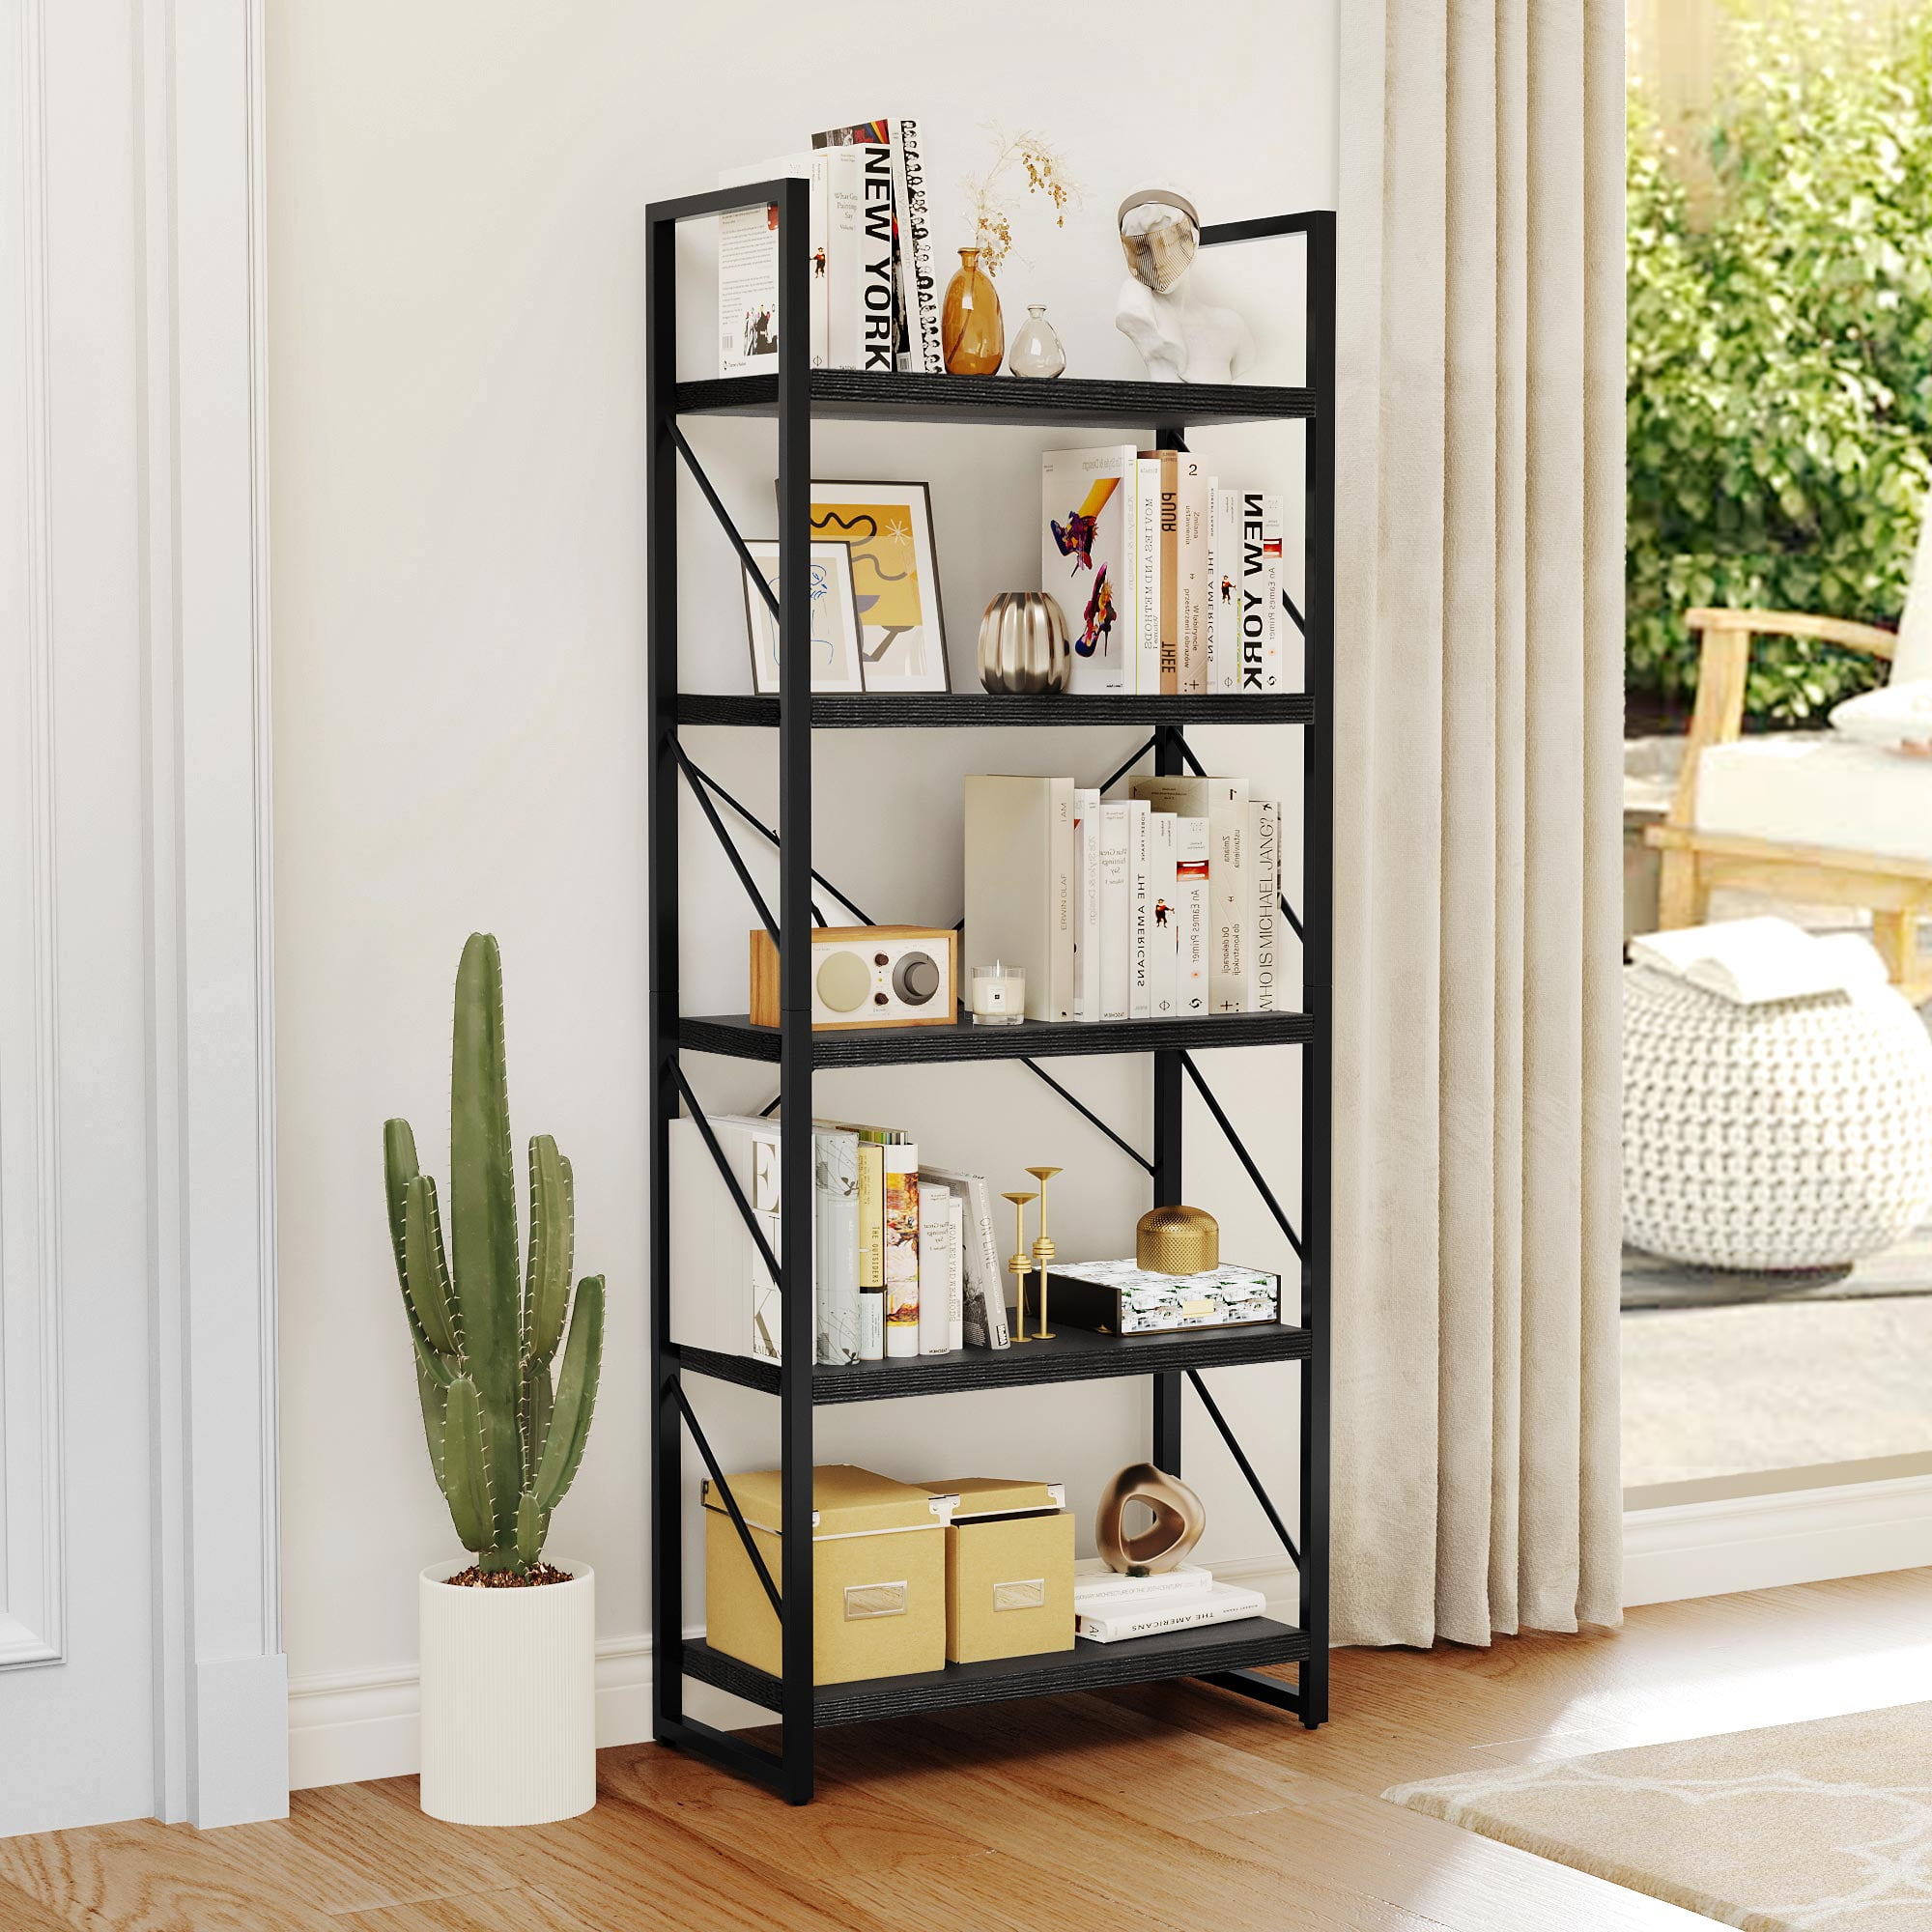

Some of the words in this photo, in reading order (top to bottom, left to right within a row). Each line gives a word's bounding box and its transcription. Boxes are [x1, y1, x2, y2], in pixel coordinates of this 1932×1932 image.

[865, 147, 891, 242] NEW
[865, 253, 891, 371] YORK
[1188, 464, 1198, 476] 2
[1259, 817, 1273, 870] JANG?
[1259, 872, 1273, 949] MICHAEL
[1259, 952, 1273, 967] IS
[1259, 971, 1273, 1012] WHO
[1131, 1615, 1192, 1632] AMERICANS
[1195, 1611, 1214, 1621] THE
